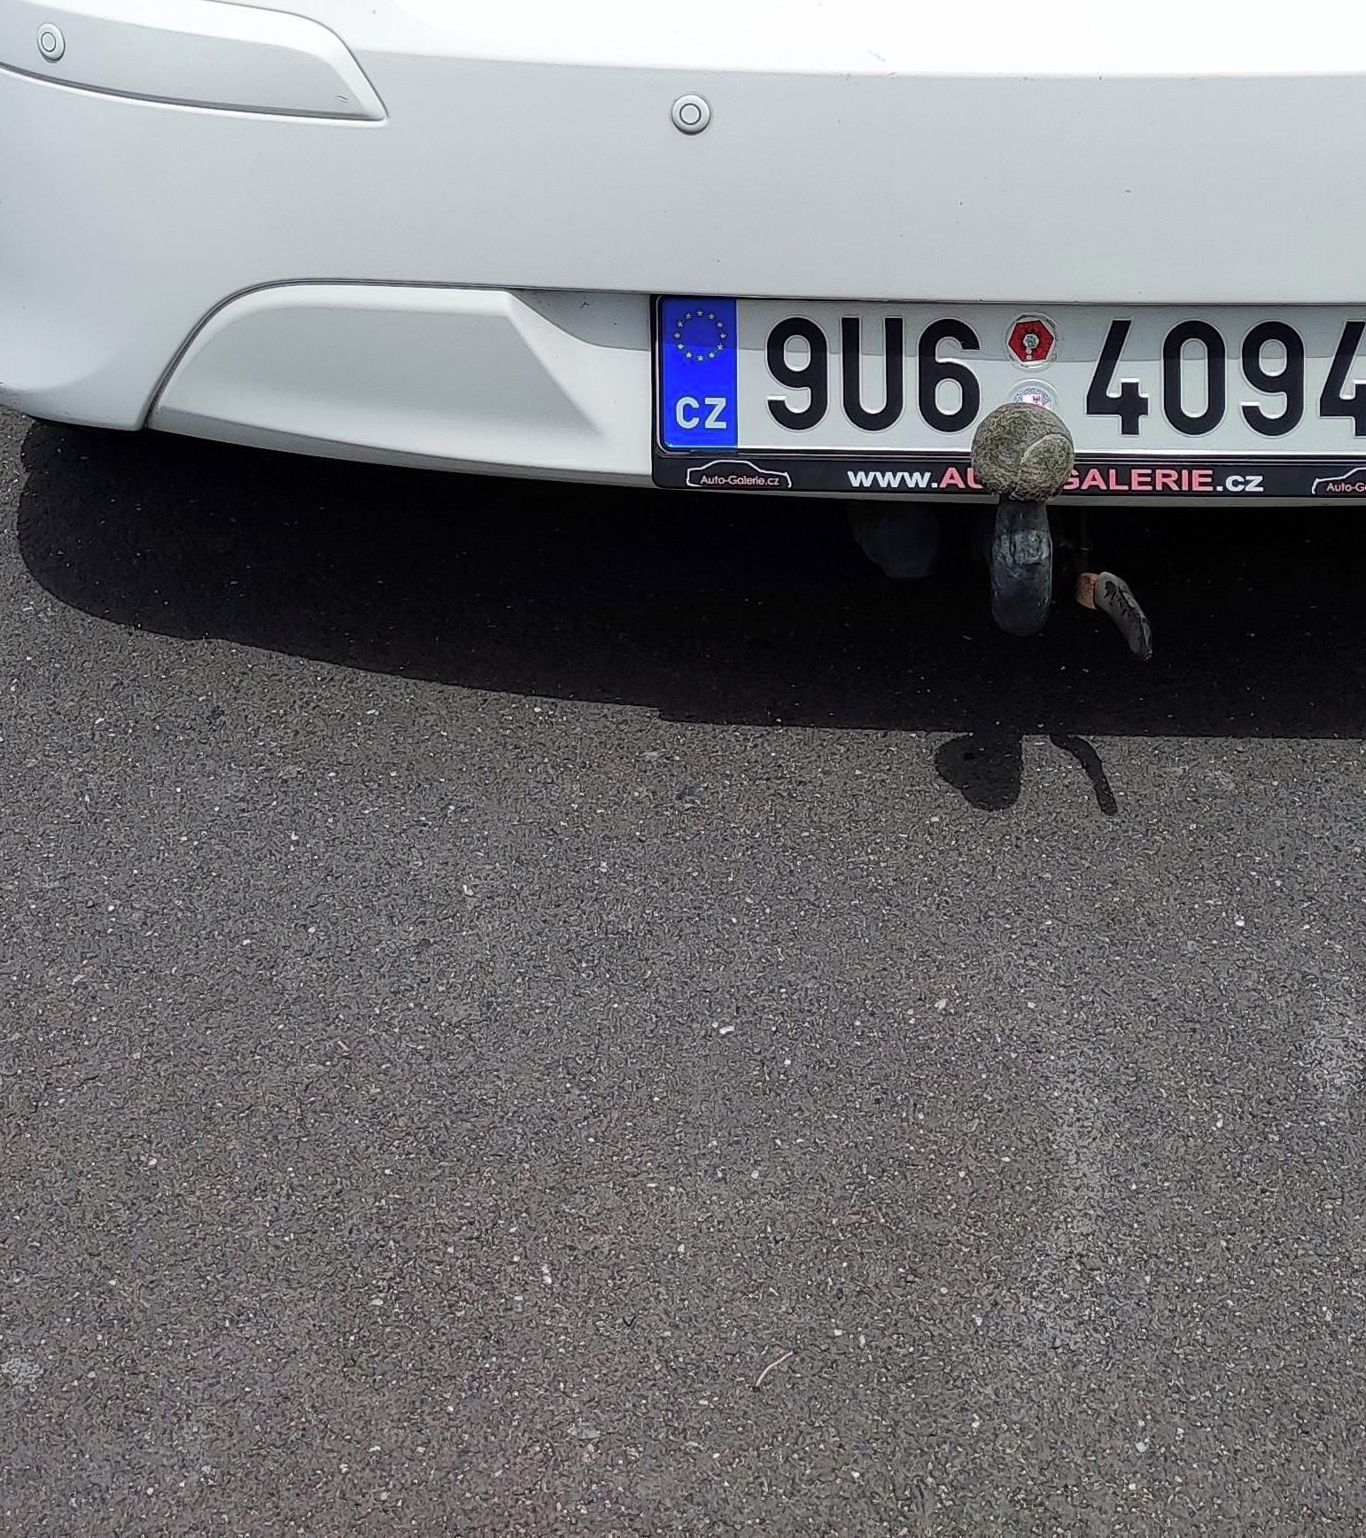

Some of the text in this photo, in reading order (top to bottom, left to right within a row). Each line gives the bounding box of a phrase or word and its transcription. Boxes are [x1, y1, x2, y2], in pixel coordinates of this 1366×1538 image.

[765, 315, 982, 434] 9U6
[675, 397, 728, 430] CZ
[700, 474, 780, 487] Auto-Galerie.cz
